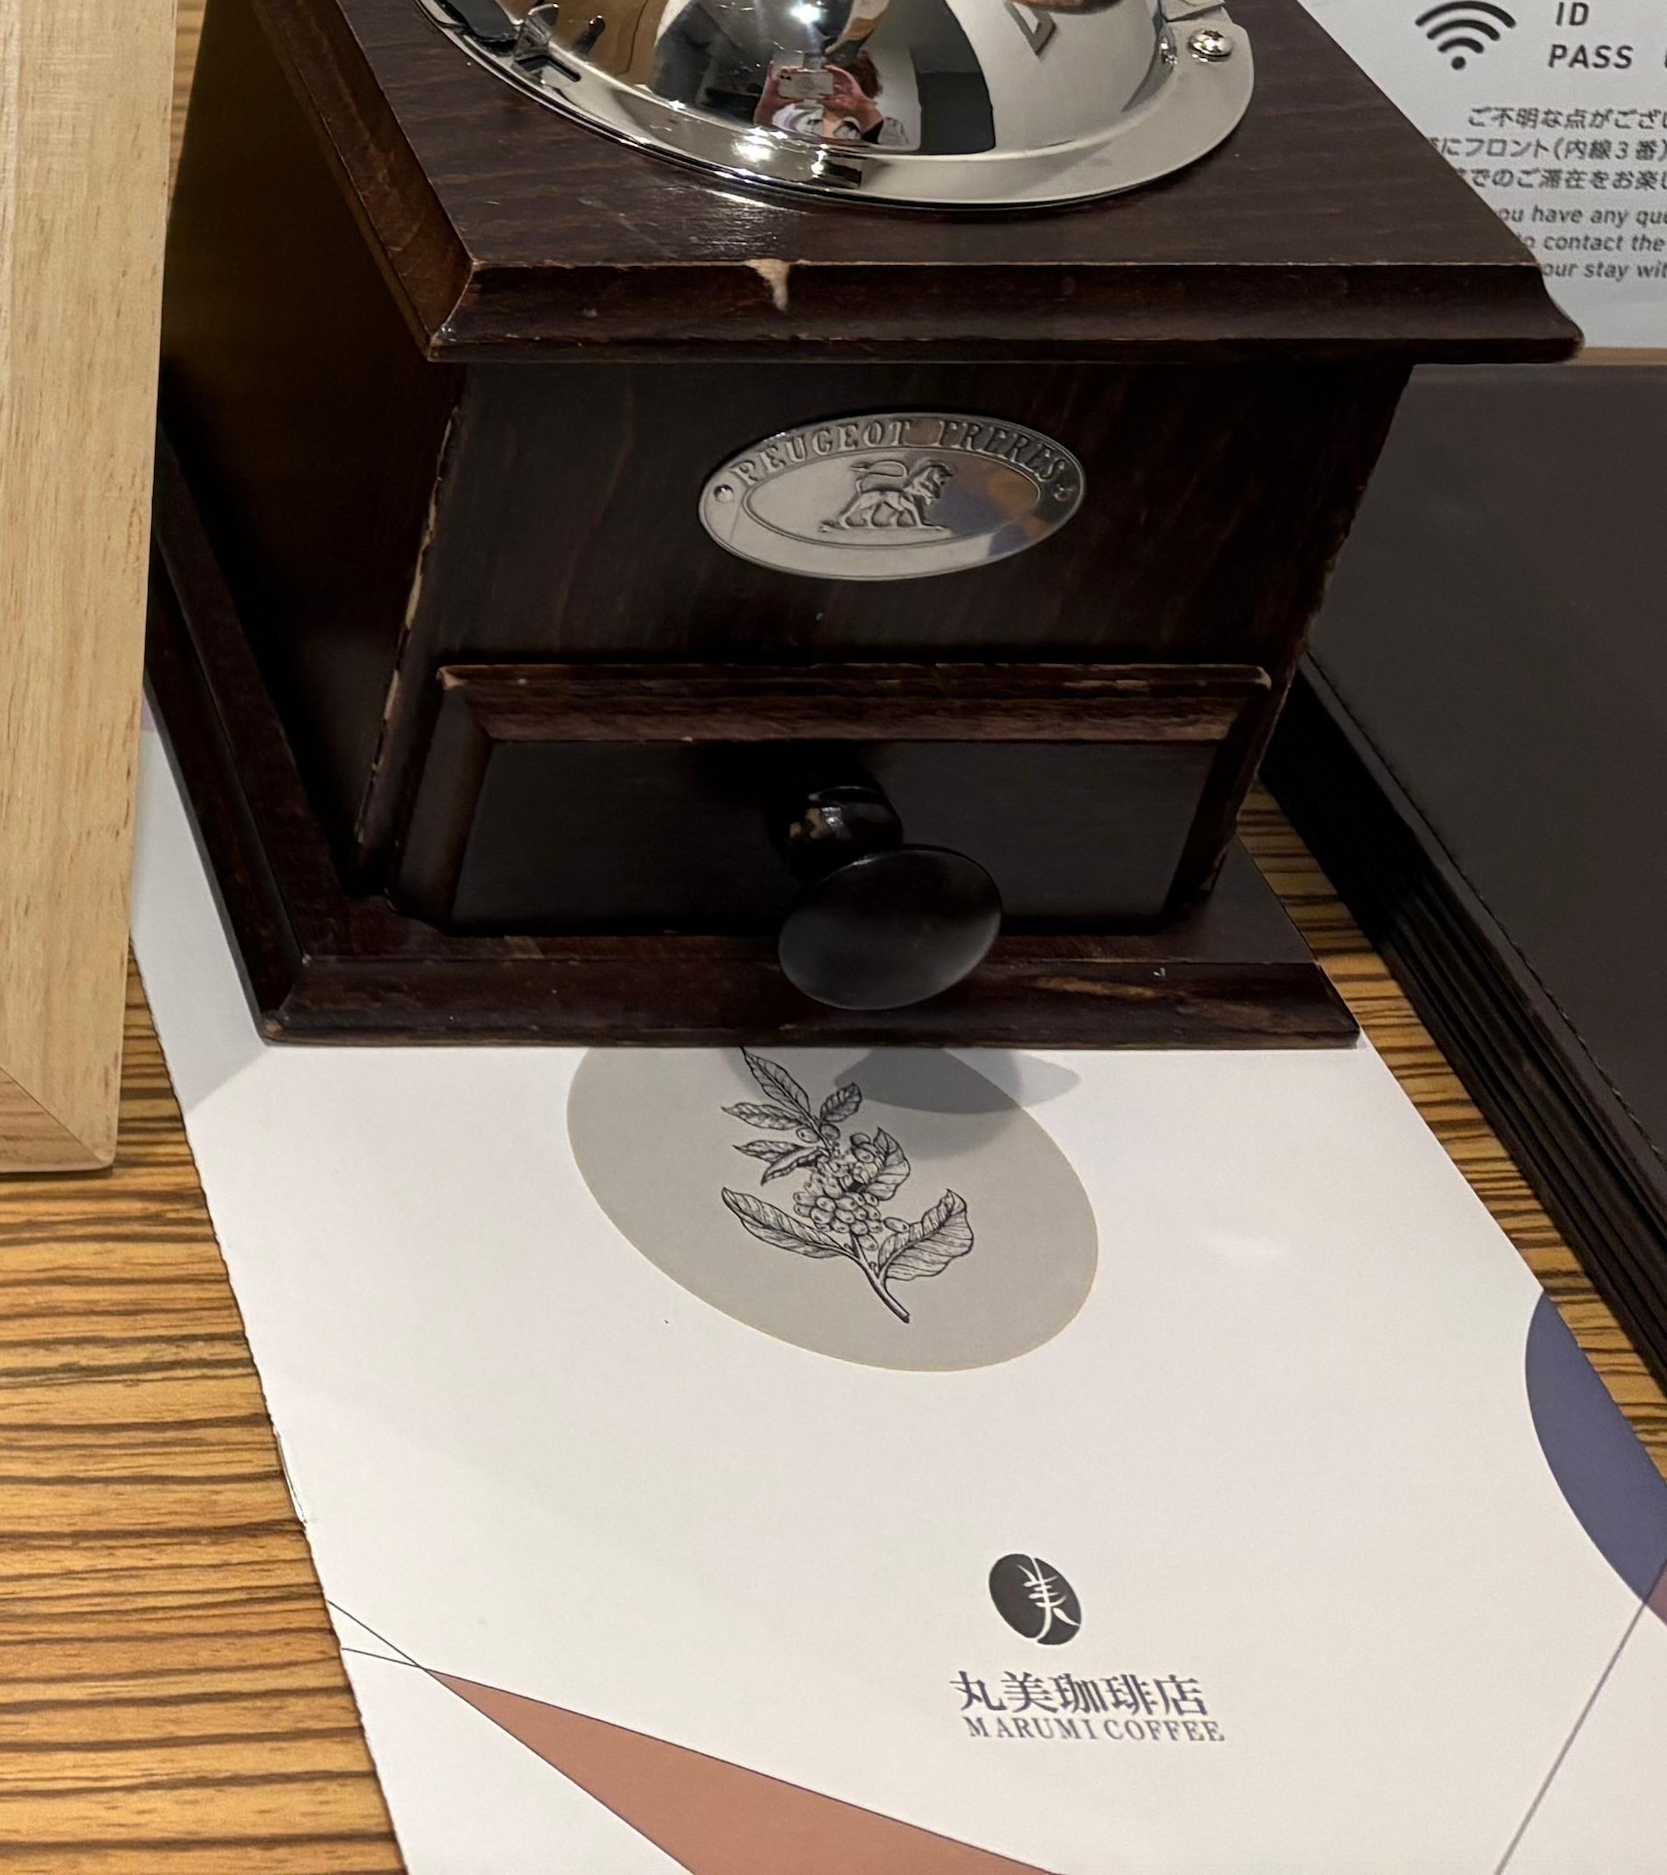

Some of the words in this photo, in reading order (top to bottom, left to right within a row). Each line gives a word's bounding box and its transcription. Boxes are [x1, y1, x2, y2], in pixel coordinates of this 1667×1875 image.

[1555, 1, 1589, 26] ID
[1547, 43, 1635, 69] PASS
[1498, 208, 1524, 222] ou
[1531, 205, 1583, 223] have
[1590, 209, 1629, 228] any
[1543, 234, 1624, 252] contact
[1631, 234, 1665, 252] the
[1542, 263, 1579, 277] our
[1583, 261, 1629, 282] stay
[730, 420, 910, 487] PEUGEOT
[949, 1669, 1209, 1717] 丸美珈琲店
[962, 1716, 1099, 1740] MARUMI
[1104, 1718, 1226, 1742] COFFEE
